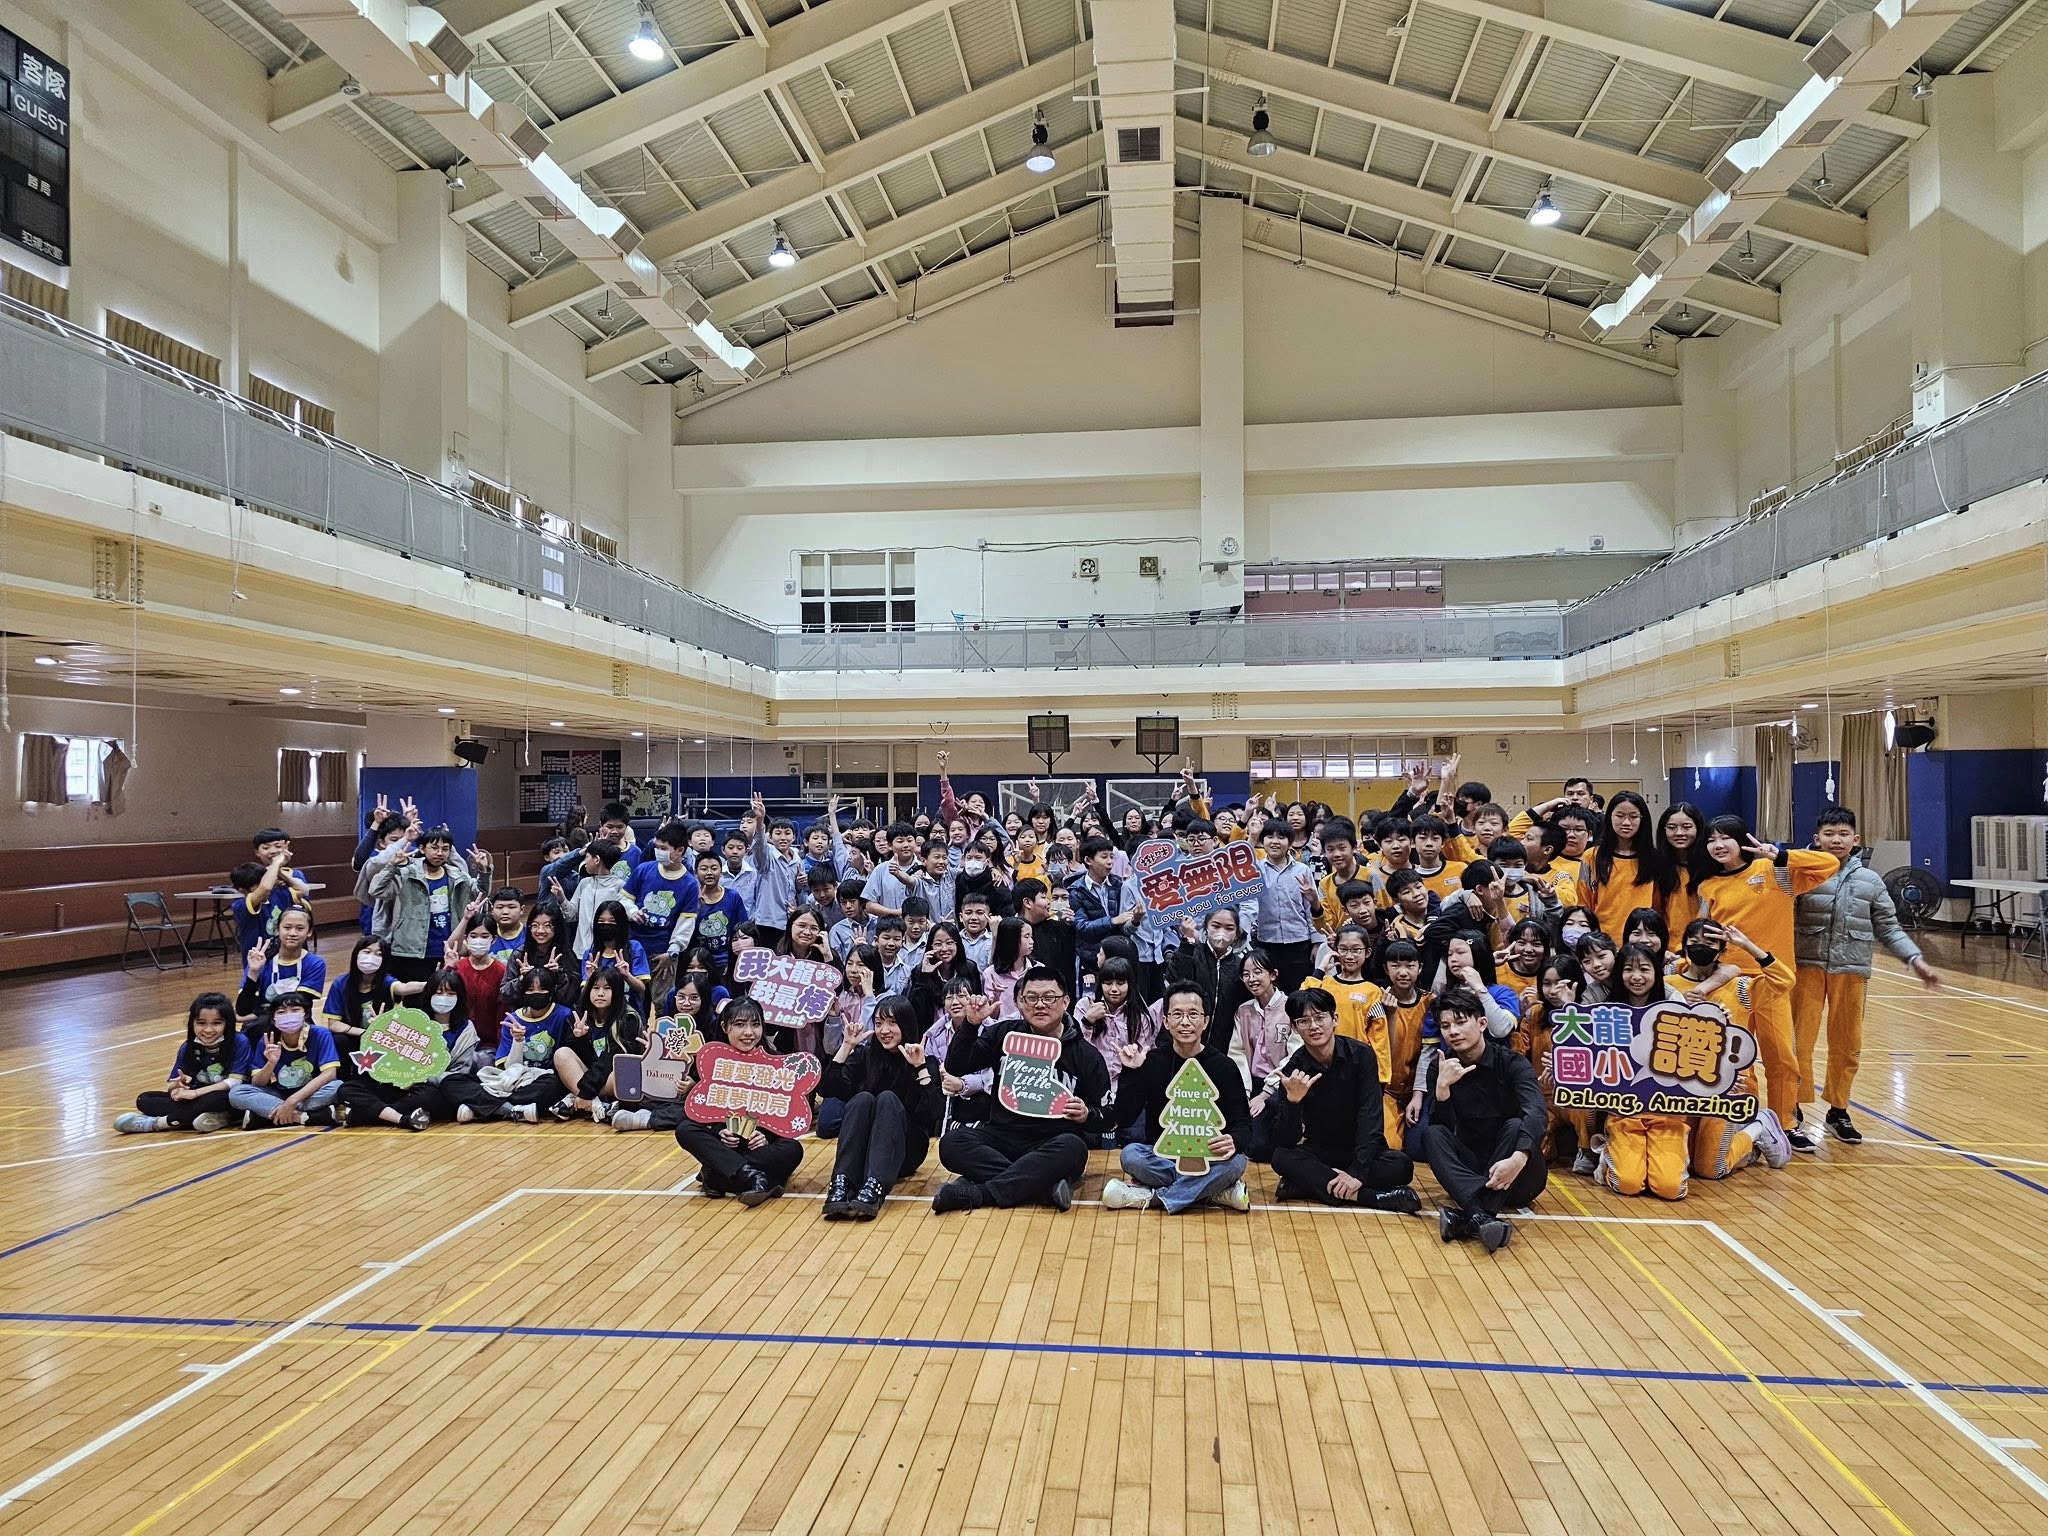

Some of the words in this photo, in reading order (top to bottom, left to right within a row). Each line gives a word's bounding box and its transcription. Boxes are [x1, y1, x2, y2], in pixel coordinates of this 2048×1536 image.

[23, 52, 66, 101] 客隊
[14, 93, 68, 136] GUEST
[1141, 844, 1260, 912] 愛無限
[1153, 909, 1185, 926] Love
[1188, 900, 1211, 915] you
[1215, 882, 1264, 905] forever
[738, 949, 816, 985] 我大龍
[750, 980, 833, 1019] 我最棒
[386, 1020, 431, 1049] 聖誕快樂
[774, 1010, 806, 1026] best
[1553, 1006, 1633, 1045] 大龍
[371, 1030, 432, 1065] 我在大龍國小
[646, 1069, 675, 1080] DaLong
[712, 1058, 795, 1091] 讓愛發光
[1006, 1059, 1050, 1078] Merry
[1013, 1072, 1052, 1089] Little
[1555, 1046, 1634, 1086] 國小
[706, 1083, 791, 1117] 讓夢閃亮
[1173, 1088, 1201, 1098] Have
[1202, 1091, 1210, 1099] a
[1554, 1087, 1644, 1116] DaLong,
[1649, 1092, 1756, 1122] Amazing!
[1168, 1121, 1214, 1137] Xmas
[1169, 1105, 1212, 1121] Merry
